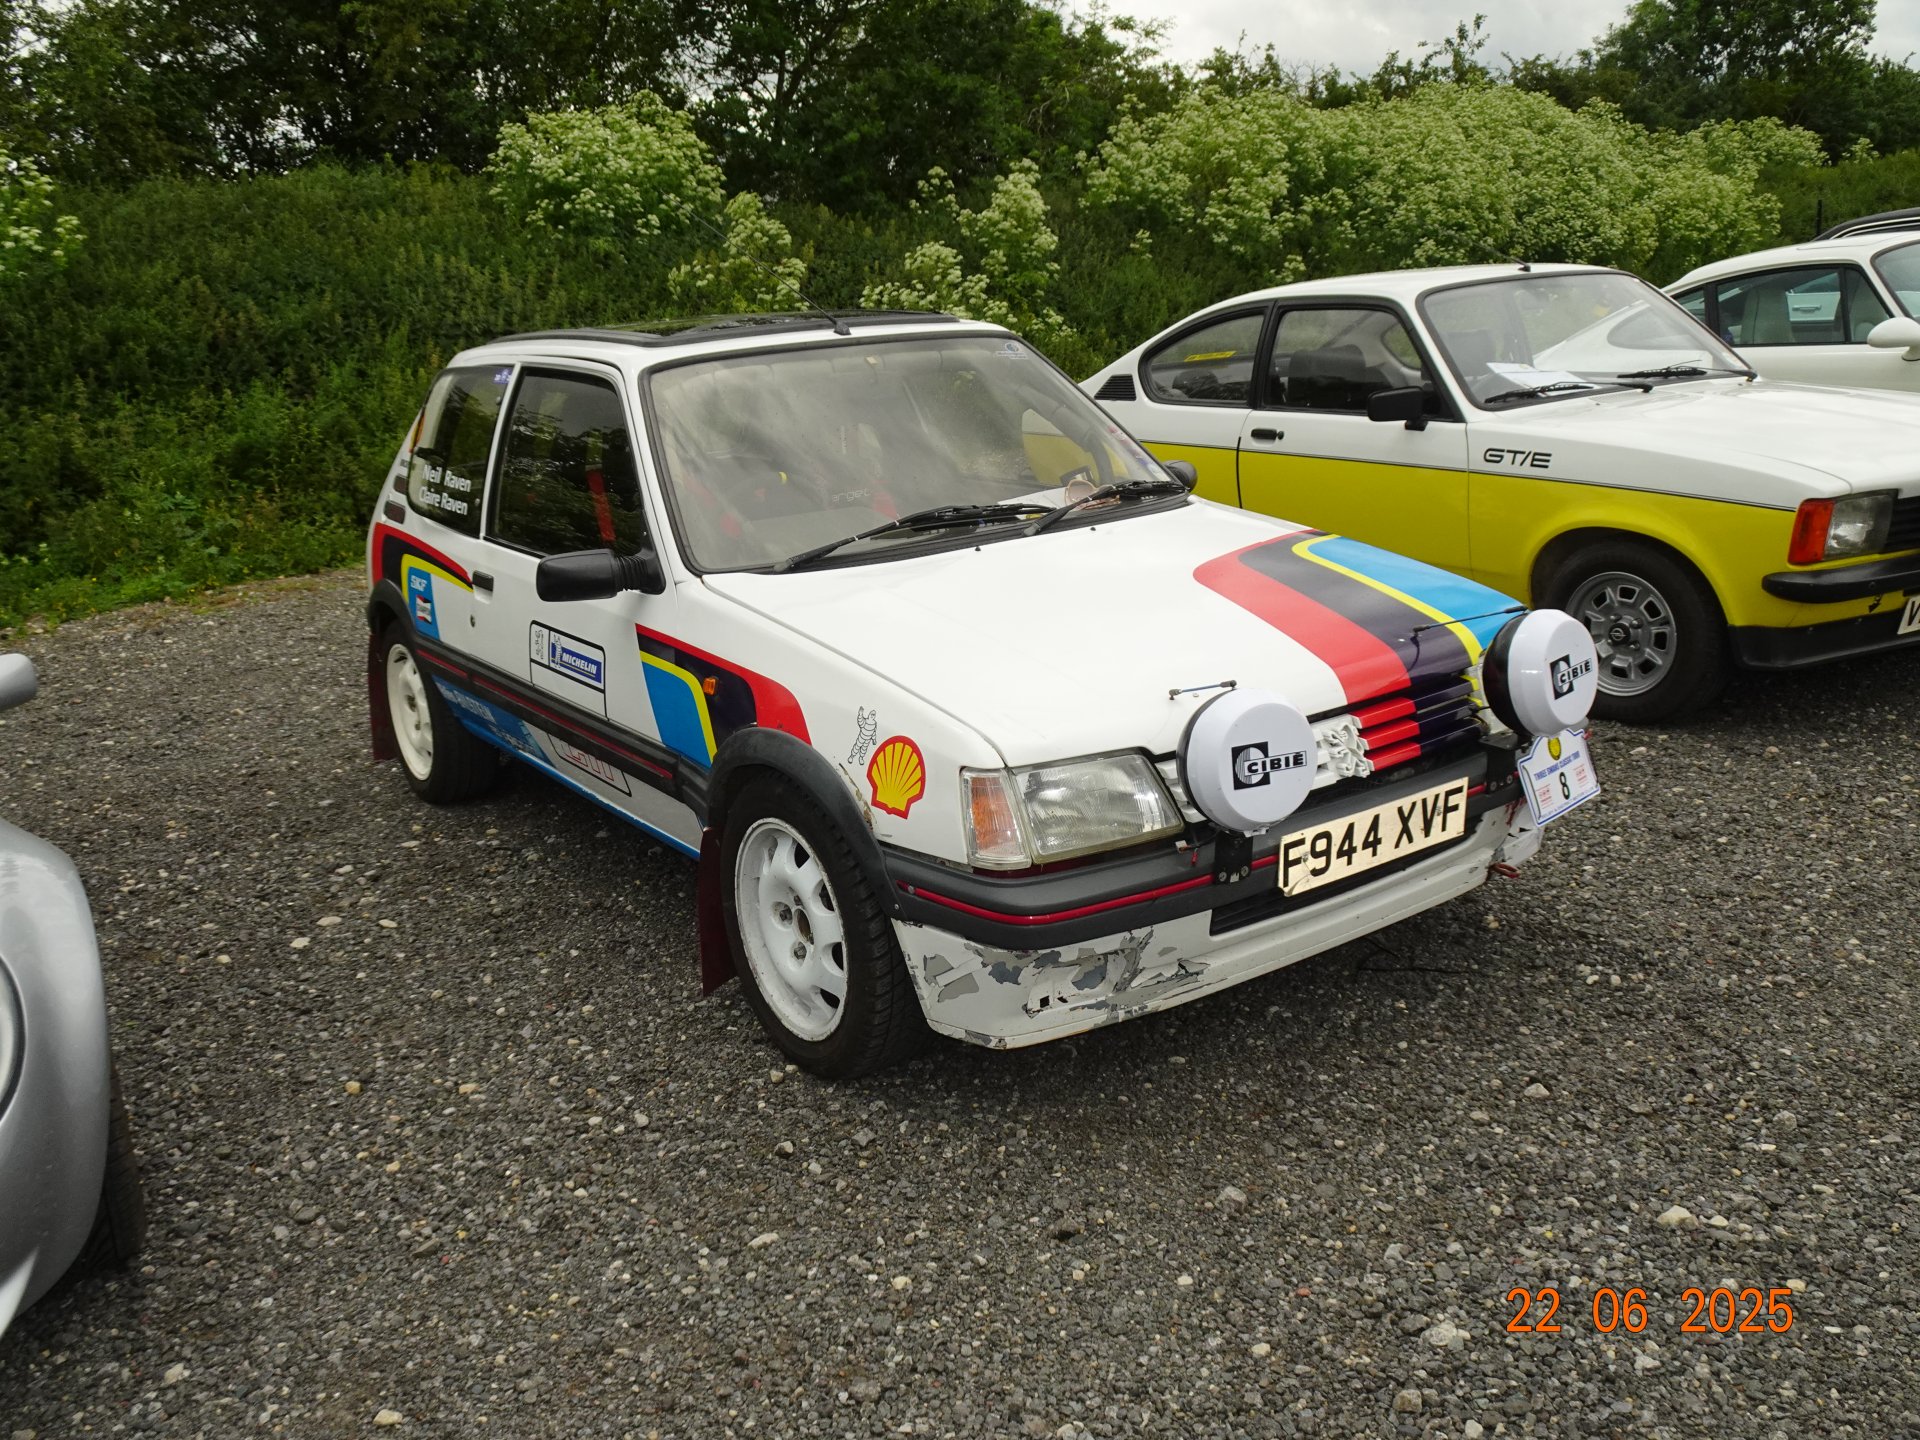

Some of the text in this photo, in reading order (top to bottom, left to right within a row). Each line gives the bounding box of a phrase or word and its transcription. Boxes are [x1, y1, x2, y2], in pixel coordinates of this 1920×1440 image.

[1484, 448, 1552, 469] GT/E
[423, 464, 471, 493] Neil Raven
[420, 486, 468, 516] Claire Raven
[561, 652, 597, 674] MICHELIN
[1560, 772, 1570, 800] 8
[1283, 813, 1382, 889] F944
[1394, 785, 1465, 849] XVF
